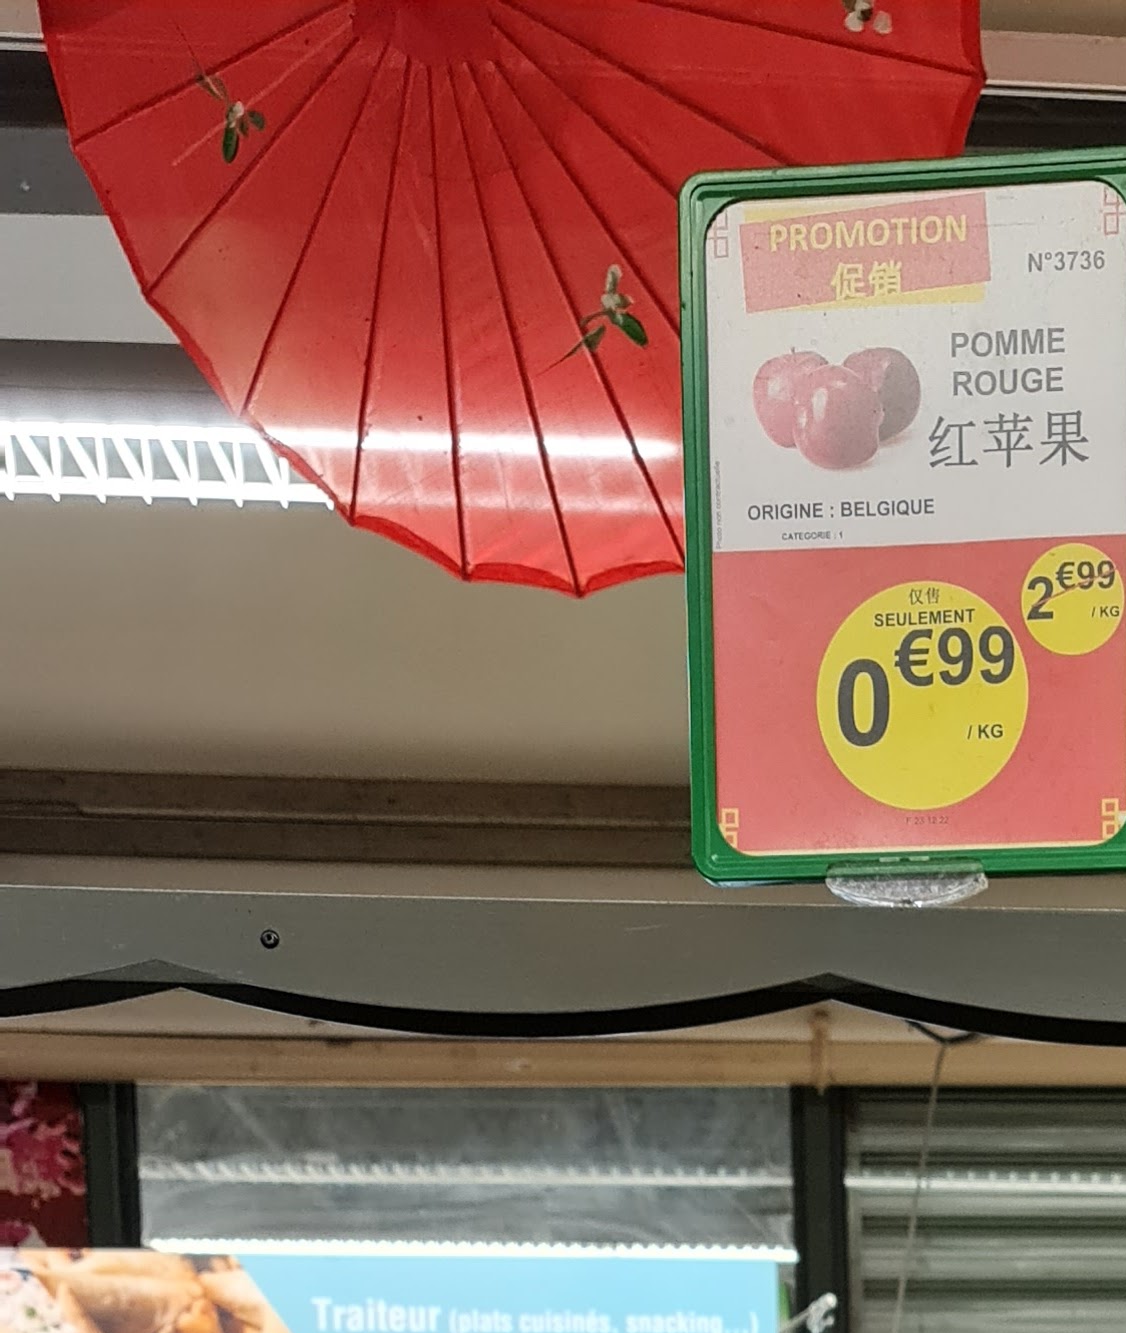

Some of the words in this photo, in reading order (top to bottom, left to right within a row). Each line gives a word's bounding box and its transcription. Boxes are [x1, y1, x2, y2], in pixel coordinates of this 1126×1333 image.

[770, 214, 968, 252] PROMOTION
[1028, 250, 1105, 273] N°3736
[831, 260, 903, 300] 促销
[950, 328, 1066, 358] POMME
[952, 367, 1064, 396] ROUGE
[928, 410, 1089, 469] 红苹果
[748, 502, 824, 521] ORIGINE
[841, 498, 935, 518] BELGIQUE
[908, 587, 940, 607] 仅售
[1099, 604, 1120, 619] KG
[874, 608, 975, 628] SEULEMENT
[837, 625, 1015, 748] 0€99
[978, 723, 1004, 740] KG
[312, 1297, 442, 1333] Traiteur
